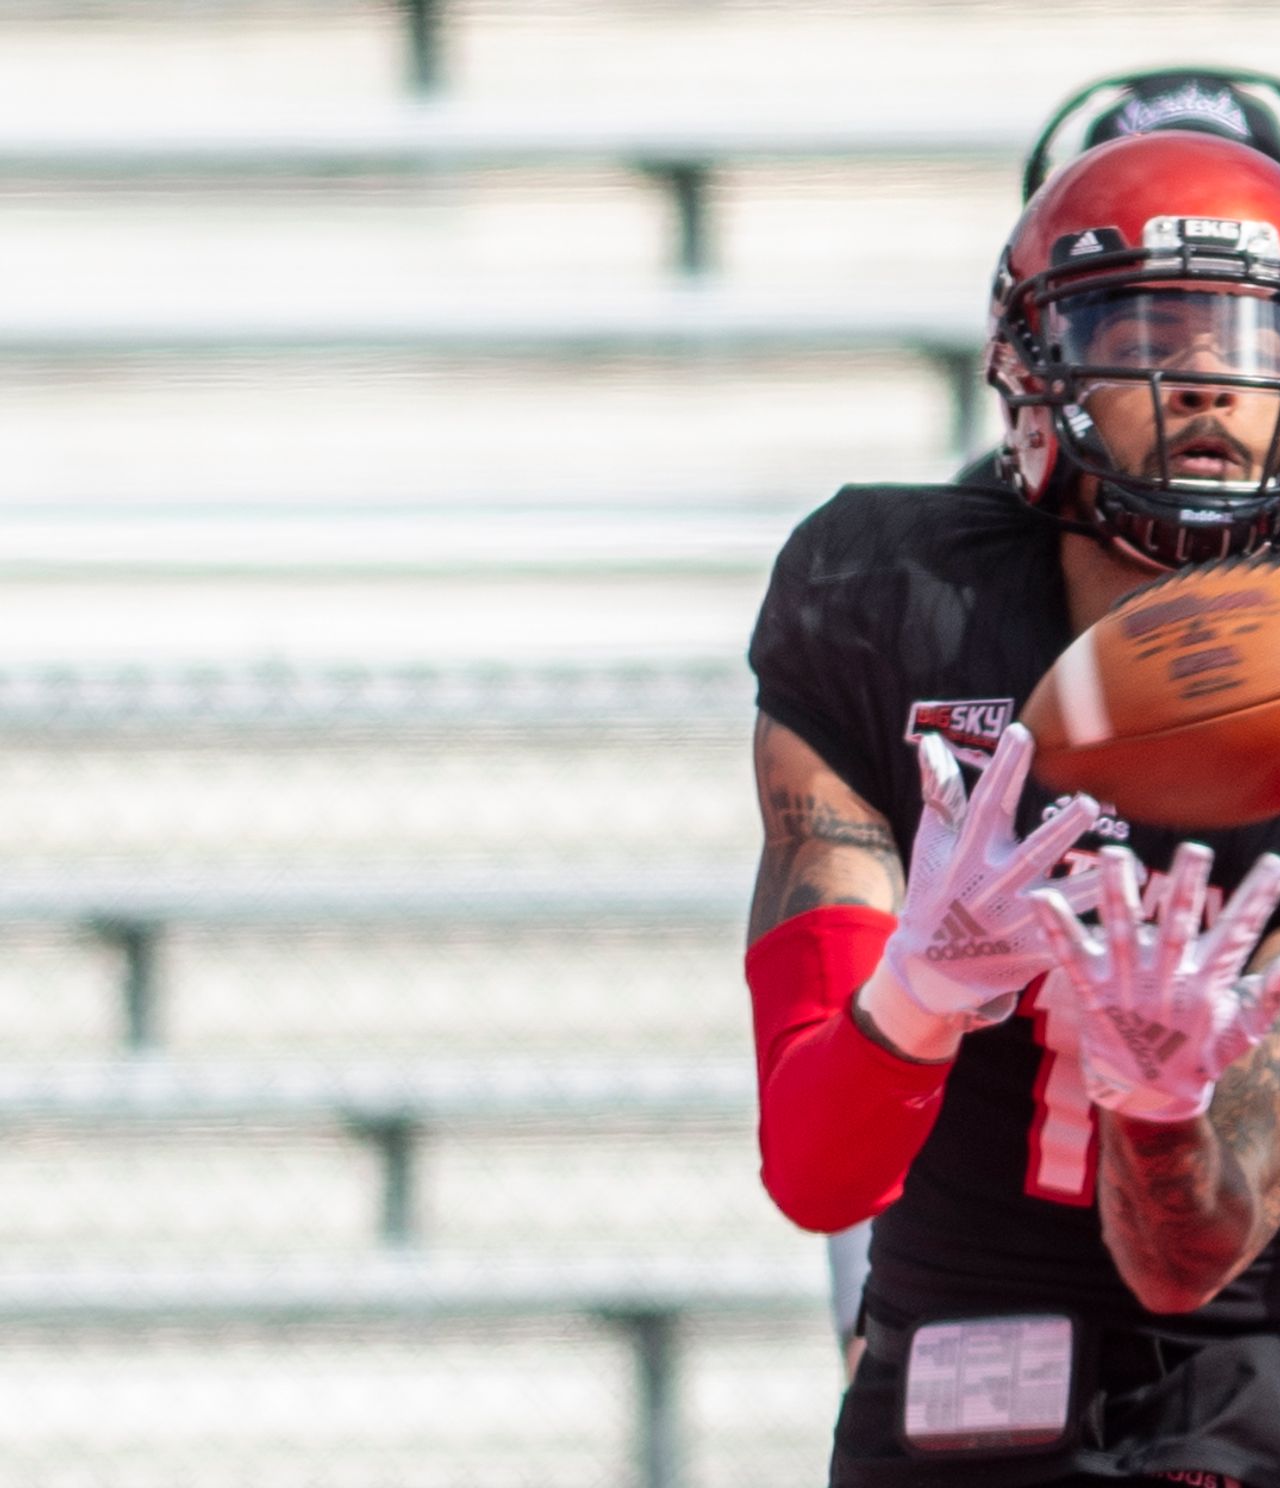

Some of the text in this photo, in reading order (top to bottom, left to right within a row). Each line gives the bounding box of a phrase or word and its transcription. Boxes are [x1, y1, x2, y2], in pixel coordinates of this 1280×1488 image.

[950, 705, 1006, 738] SKY
[925, 938, 1012, 962] adidas
[1016, 965, 1100, 1209] 1
